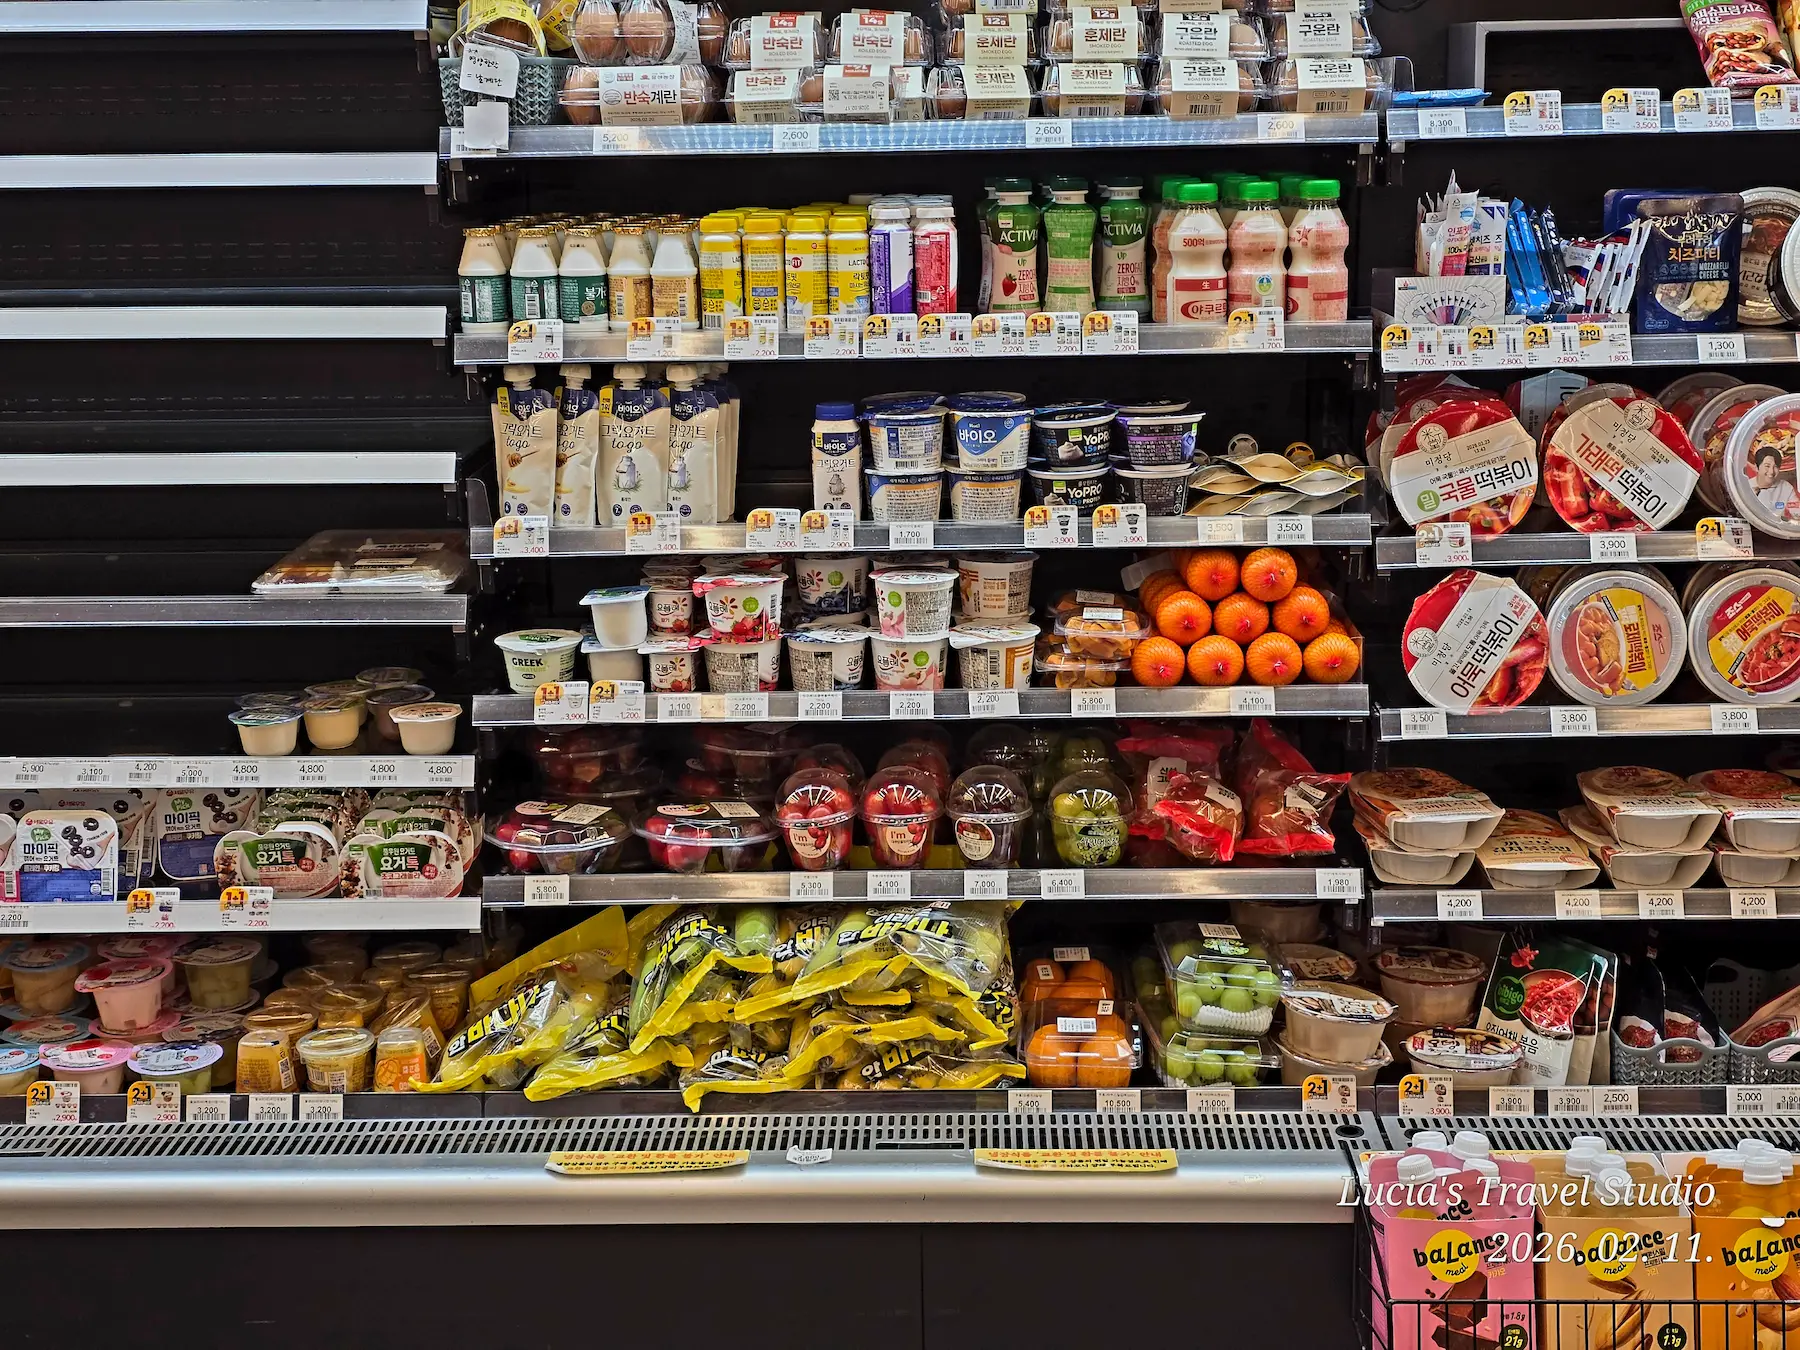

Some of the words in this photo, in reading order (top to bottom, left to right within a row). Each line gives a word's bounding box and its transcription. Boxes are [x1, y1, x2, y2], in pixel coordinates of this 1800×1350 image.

[1093, 8, 1113, 19] 12g
[986, 17, 1006, 26] 12g
[1176, 26, 1218, 40] 구운란
[1299, 23, 1340, 36] 구운란
[1084, 29, 1126, 43] 훈제란
[763, 36, 804, 50] 반숙란
[853, 35, 894, 49] 반숙란
[1183, 66, 1226, 78] 구운란
[1309, 62, 1353, 74] 구운란
[974, 71, 1016, 84] 훈제란
[1070, 69, 1113, 81] 훈제란
[746, 75, 787, 87] 반숙란
[623, 90, 677, 105] 반숙계란
[1267, 120, 1294, 132] 2,600
[1430, 119, 1453, 129] 8,300
[1538, 124, 1559, 132] 3,500
[1636, 122, 1657, 130] 3,500
[1708, 120, 1728, 129] 3,500
[783, 131, 808, 142] 2,600
[1035, 126, 1061, 137] 2,600
[603, 132, 629, 144] 5,200
[1103, 223, 1142, 237] ACTIVIA
[1668, 246, 1721, 262] 치즈파티
[1699, 272, 1719, 282] CHEESE
[1708, 340, 1734, 352] 1,300
[959, 428, 998, 448] 바이오
[1613, 421, 1637, 444] 미정당
[823, 440, 847, 451] 바이오
[1424, 452, 1453, 466] 미정당
[1576, 433, 1625, 482] 가래떡
[1616, 469, 1668, 519] 떡볶이
[1067, 483, 1102, 499] YoPRO
[1422, 493, 1437, 508] 밀
[1207, 522, 1233, 534] 3,500
[1276, 522, 1303, 534] 3,500
[899, 531, 921, 540] 1,700
[1599, 540, 1626, 551] 3,900
[708, 600, 729, 613] 요플레
[1431, 642, 1453, 667] 미정당
[511, 658, 543, 668] GREEK
[899, 701, 921, 710] 2,200
[977, 695, 1000, 705] 2,200
[1082, 697, 1103, 706] 5,800
[1242, 698, 1264, 706] 4,100
[670, 702, 691, 711] 1,100
[735, 703, 756, 712] 2,200
[809, 702, 831, 711] 2,200
[565, 712, 585, 721] 3,900
[1411, 714, 1433, 725] 3,500
[1561, 713, 1586, 724] 3,800
[1721, 711, 1747, 722] 3,800
[22, 764, 44, 775] 5,900
[81, 769, 103, 777] 3,100
[135, 763, 157, 773] 4,200
[232, 765, 258, 776] 4,800
[300, 765, 325, 776] 4,800
[370, 765, 395, 776] 4,800
[428, 766, 453, 777] 4,800
[182, 770, 203, 778] 5,000
[164, 811, 200, 825] 마이픽
[23, 843, 59, 855] 마이픽
[801, 882, 822, 890] 5,300
[878, 881, 899, 889] 4,100
[975, 880, 996, 889] 7,000
[1052, 879, 1073, 888] 6,400
[1328, 879, 1350, 888] 1,980
[536, 886, 557, 894] 5,800
[1447, 898, 1471, 909] 4,200
[1565, 897, 1589, 908] 4,200
[1648, 897, 1673, 908] 4,200
[1740, 896, 1766, 907] 4,200
[0, 913, 22, 922] 2,200
[154, 921, 175, 930] 2,200
[248, 920, 269, 929] 2,200
[31, 1086, 51, 1100] 2+1
[132, 1085, 152, 1100] 2+1
[1307, 1079, 1328, 1096] 2+1
[1403, 1079, 1424, 1096] 2+1
[1500, 1097, 1522, 1106] 3,900
[1559, 1097, 1581, 1106] 3,900
[1603, 1092, 1629, 1103] 2,500
[1736, 1092, 1762, 1103] 5,000
[1018, 1100, 1040, 1109] 5,400
[1104, 1099, 1131, 1109] 10,500
[1200, 1099, 1227, 1108] 11,000
[197, 1106, 218, 1115] 3,200
[260, 1106, 281, 1115] 3,200
[310, 1106, 332, 1114] 3,200
[55, 1114, 75, 1123] 2,900
[158, 1113, 177, 1122] 2,900
[1446, 1262, 1469, 1277] meal
[1603, 1262, 1628, 1276] meal
[1754, 1261, 1778, 1276] meal
[1504, 1335, 1524, 1349] 21g
